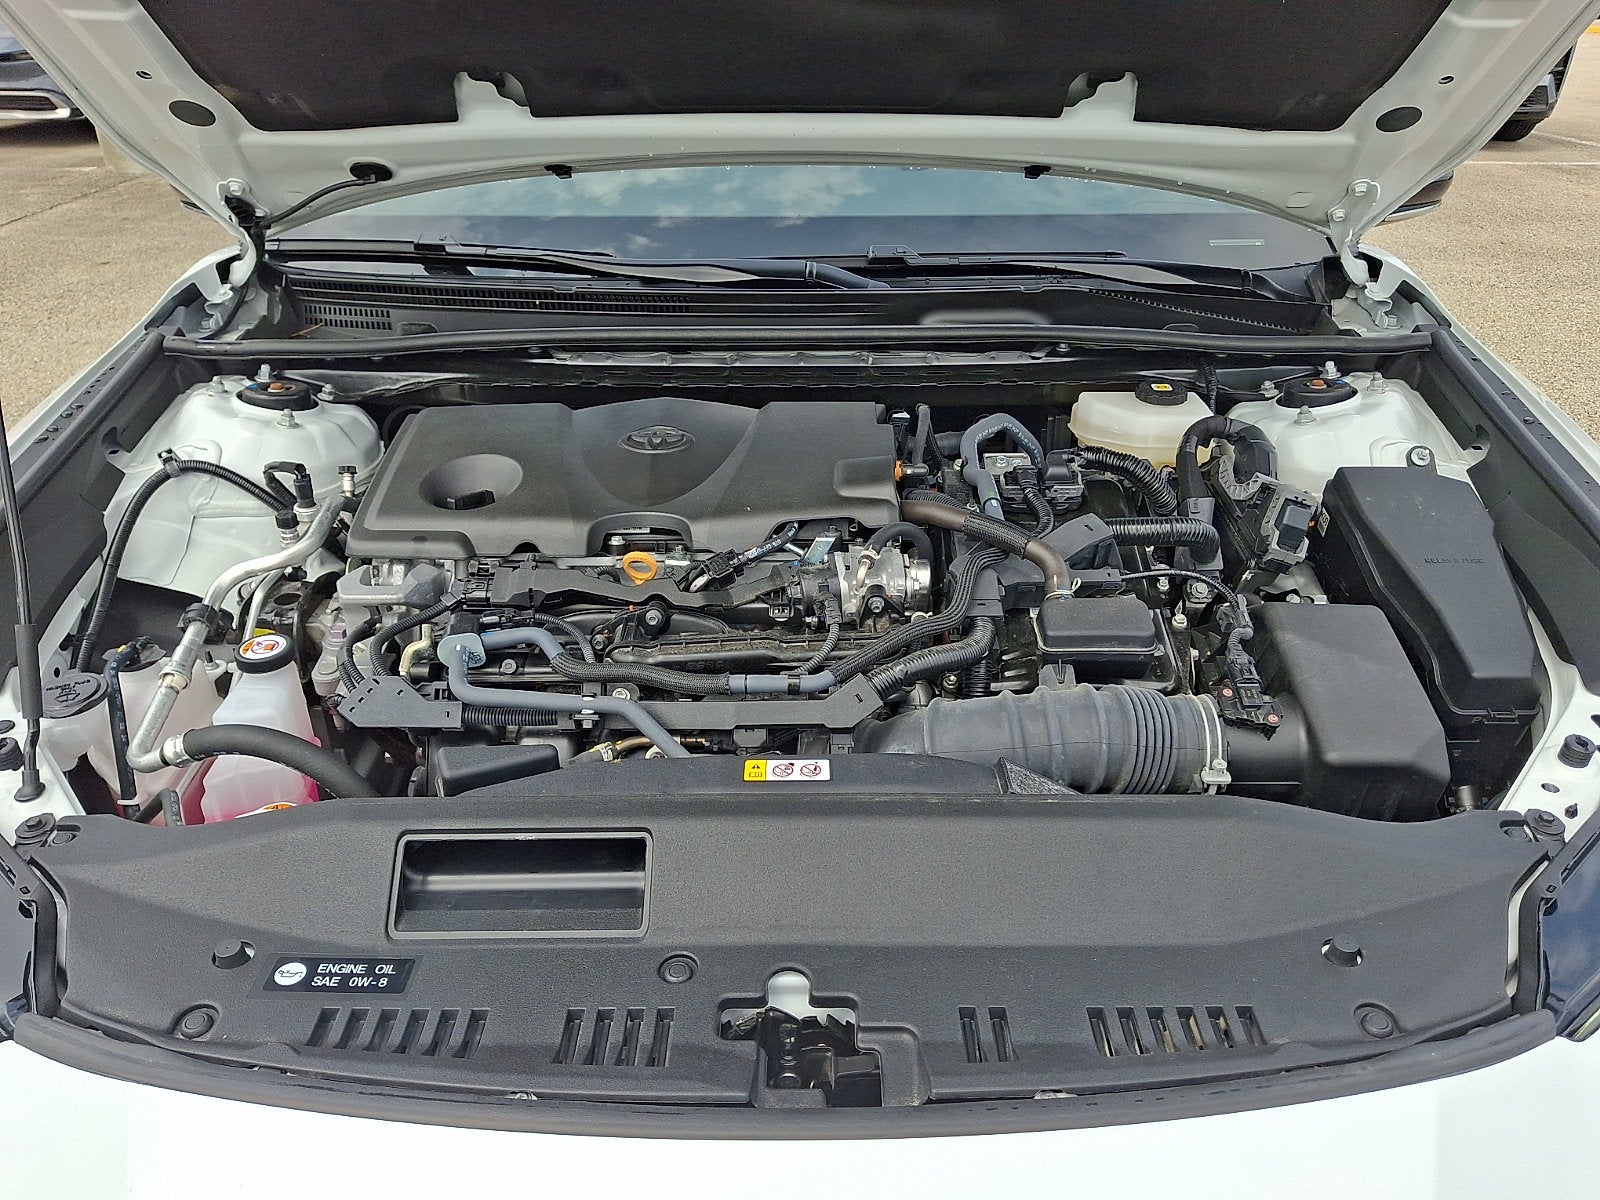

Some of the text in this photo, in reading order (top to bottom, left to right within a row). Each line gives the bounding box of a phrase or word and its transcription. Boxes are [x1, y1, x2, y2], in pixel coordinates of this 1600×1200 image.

[317, 963, 396, 975] ENGINE OIL
[311, 976, 389, 988] SAE 0W-8
